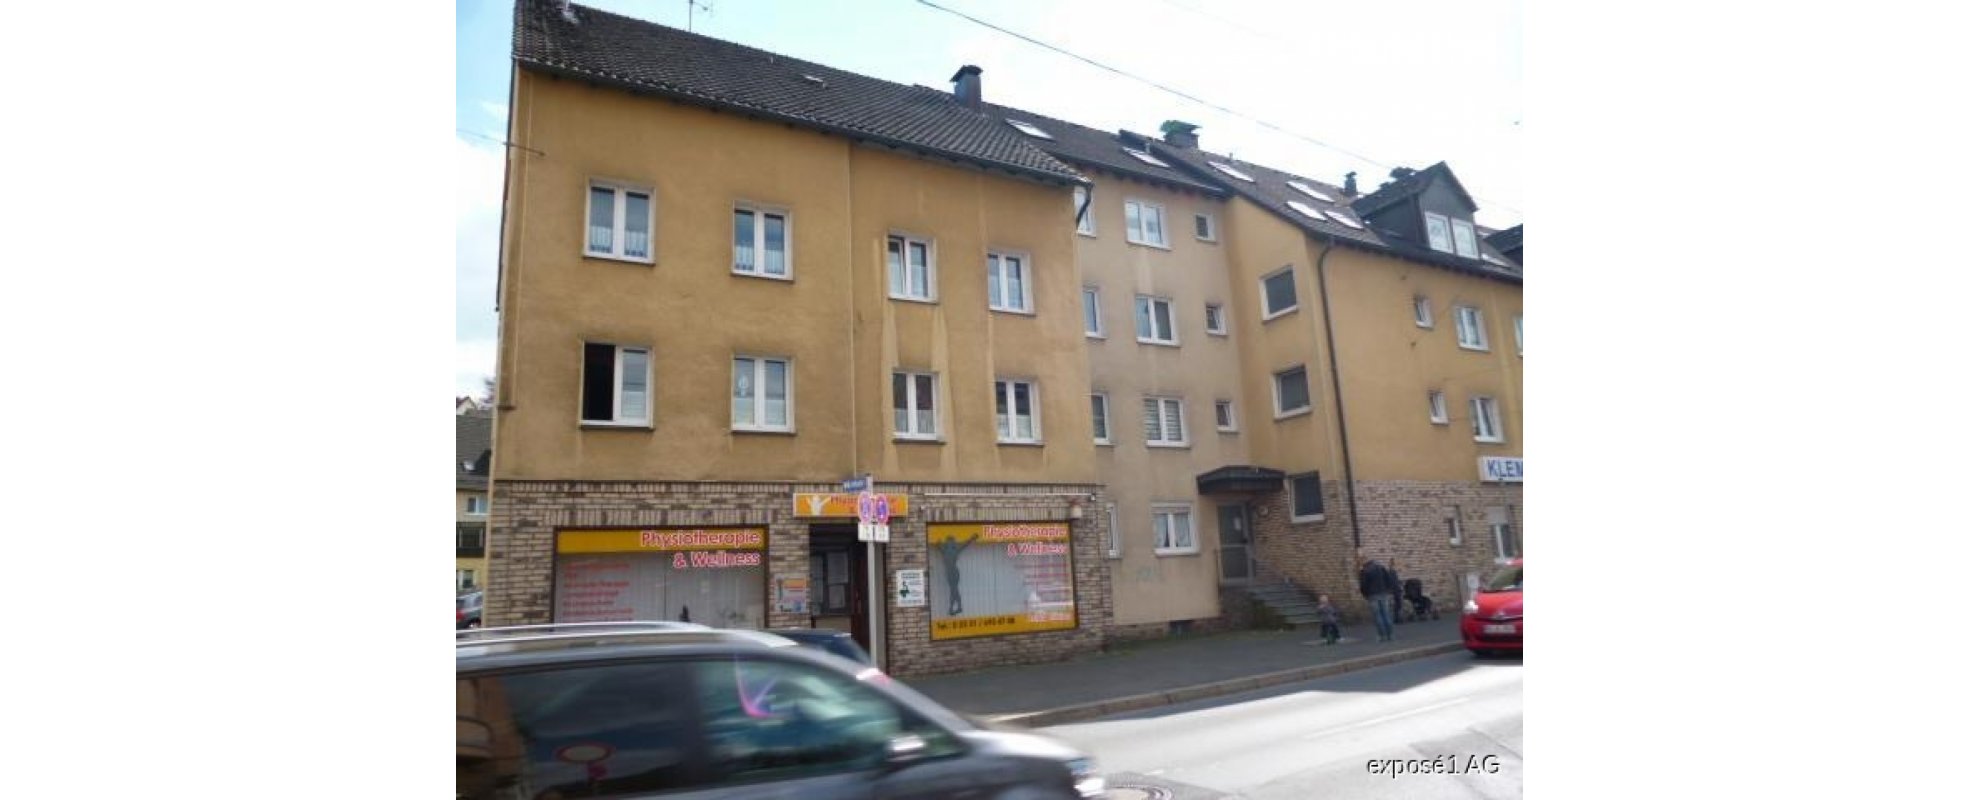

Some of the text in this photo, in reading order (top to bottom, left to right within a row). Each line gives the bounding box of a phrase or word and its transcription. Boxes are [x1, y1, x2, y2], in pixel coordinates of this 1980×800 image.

[640, 530, 761, 550] Physiotherapie
[982, 525, 1068, 540] Physiotherapie
[1019, 541, 1068, 555] Wellness
[673, 551, 761, 569] & Wellness
